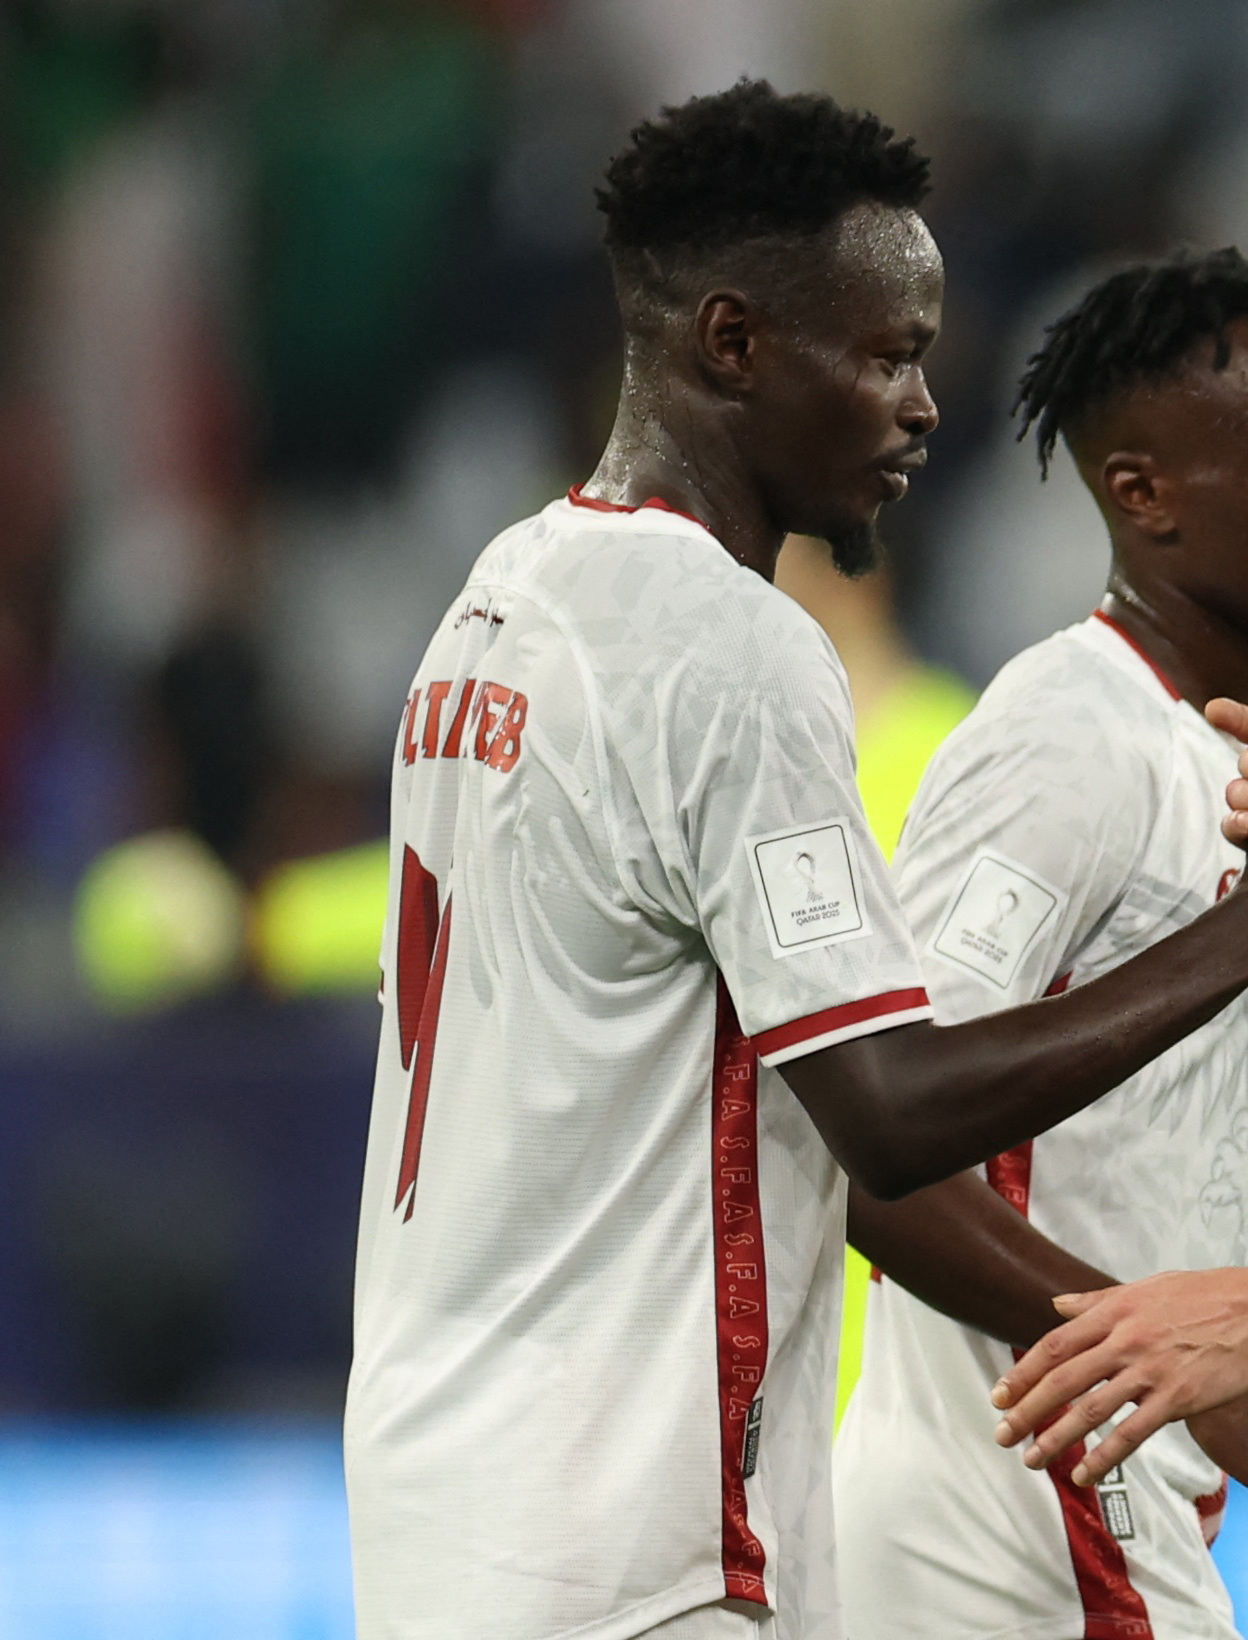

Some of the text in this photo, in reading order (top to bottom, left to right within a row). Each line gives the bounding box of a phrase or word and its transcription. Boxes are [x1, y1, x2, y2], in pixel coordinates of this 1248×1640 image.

[791, 900, 840, 918] FIFA ARAB CUP
[796, 909, 840, 926] QATAR 2025
